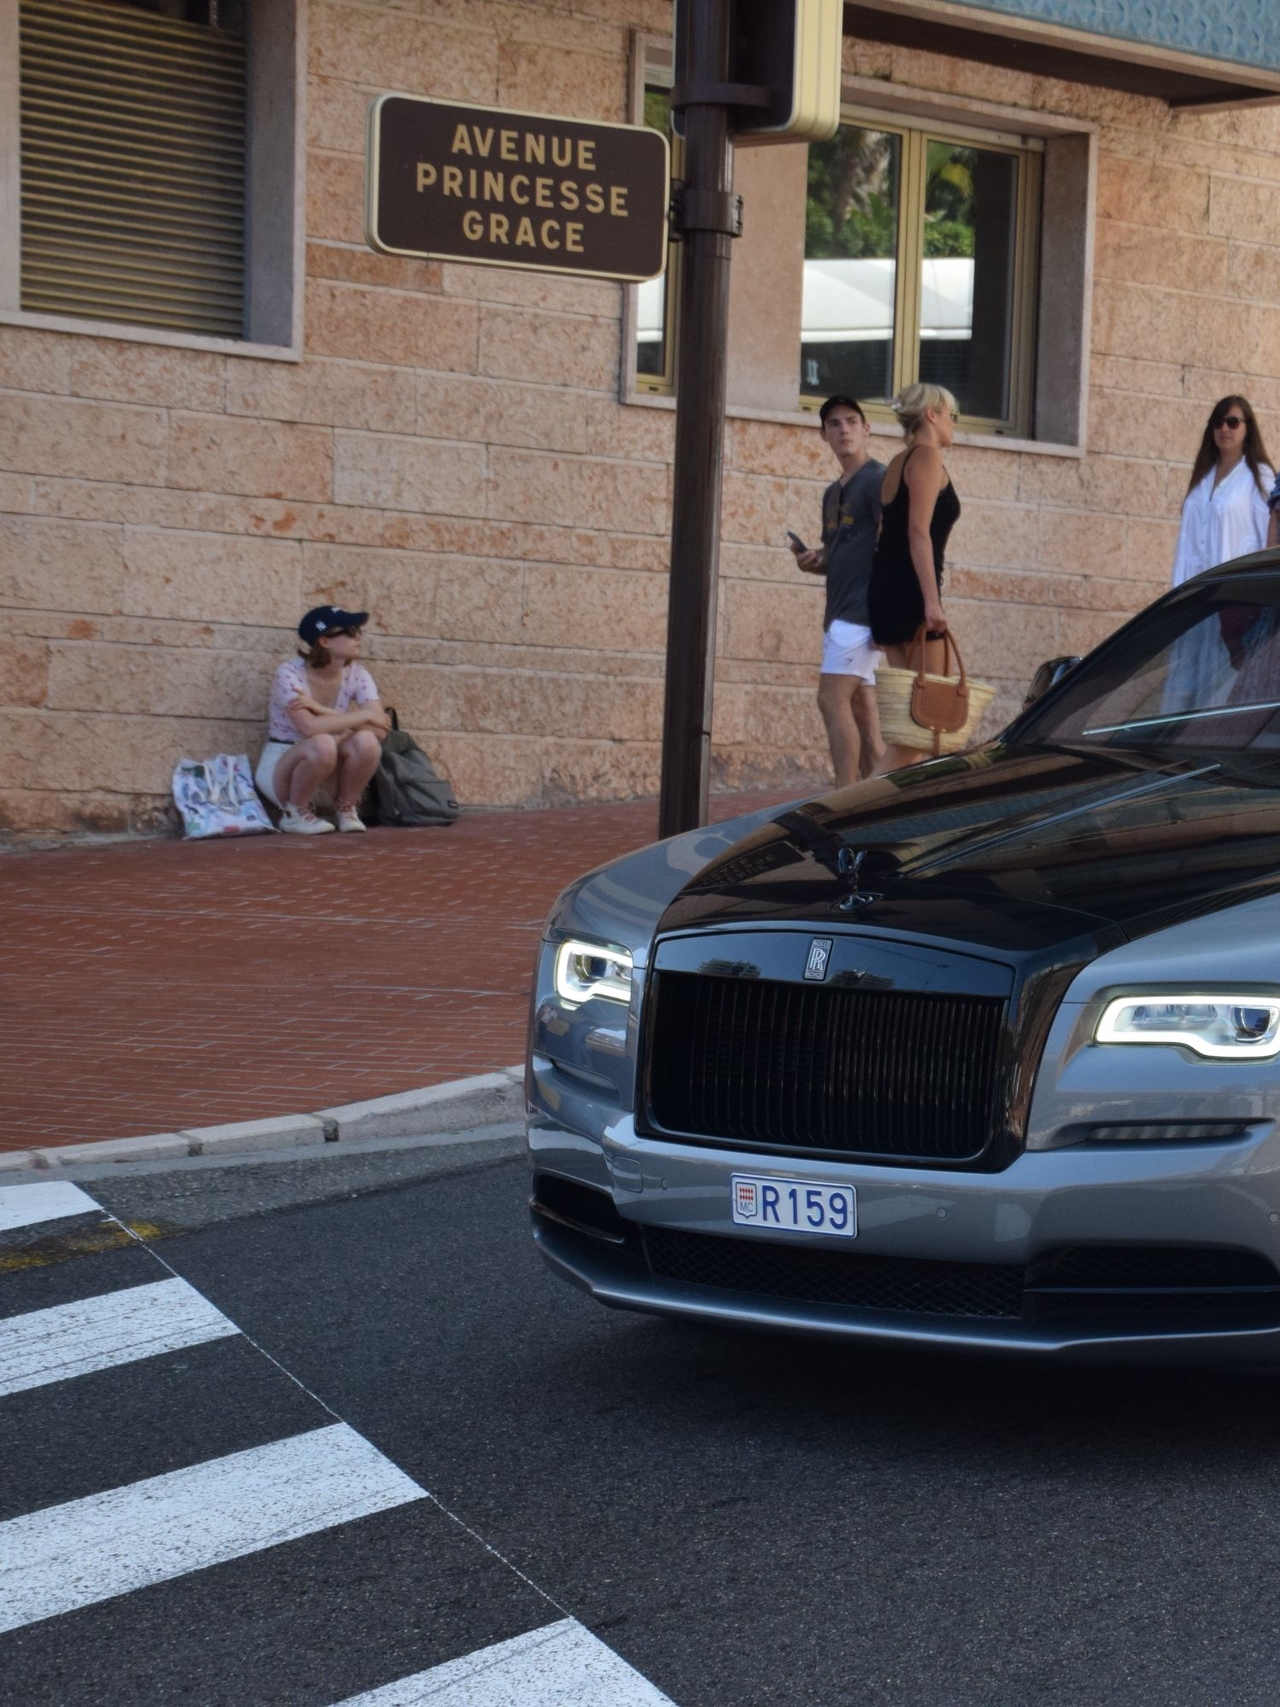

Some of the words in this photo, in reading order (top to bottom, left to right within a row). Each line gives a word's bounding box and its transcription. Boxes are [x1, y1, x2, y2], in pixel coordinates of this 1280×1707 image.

[451, 123, 596, 171] AVENUE
[416, 162, 629, 217] PRINCESSE
[462, 210, 584, 253] GRACE
[762, 1185, 848, 1230] R159
